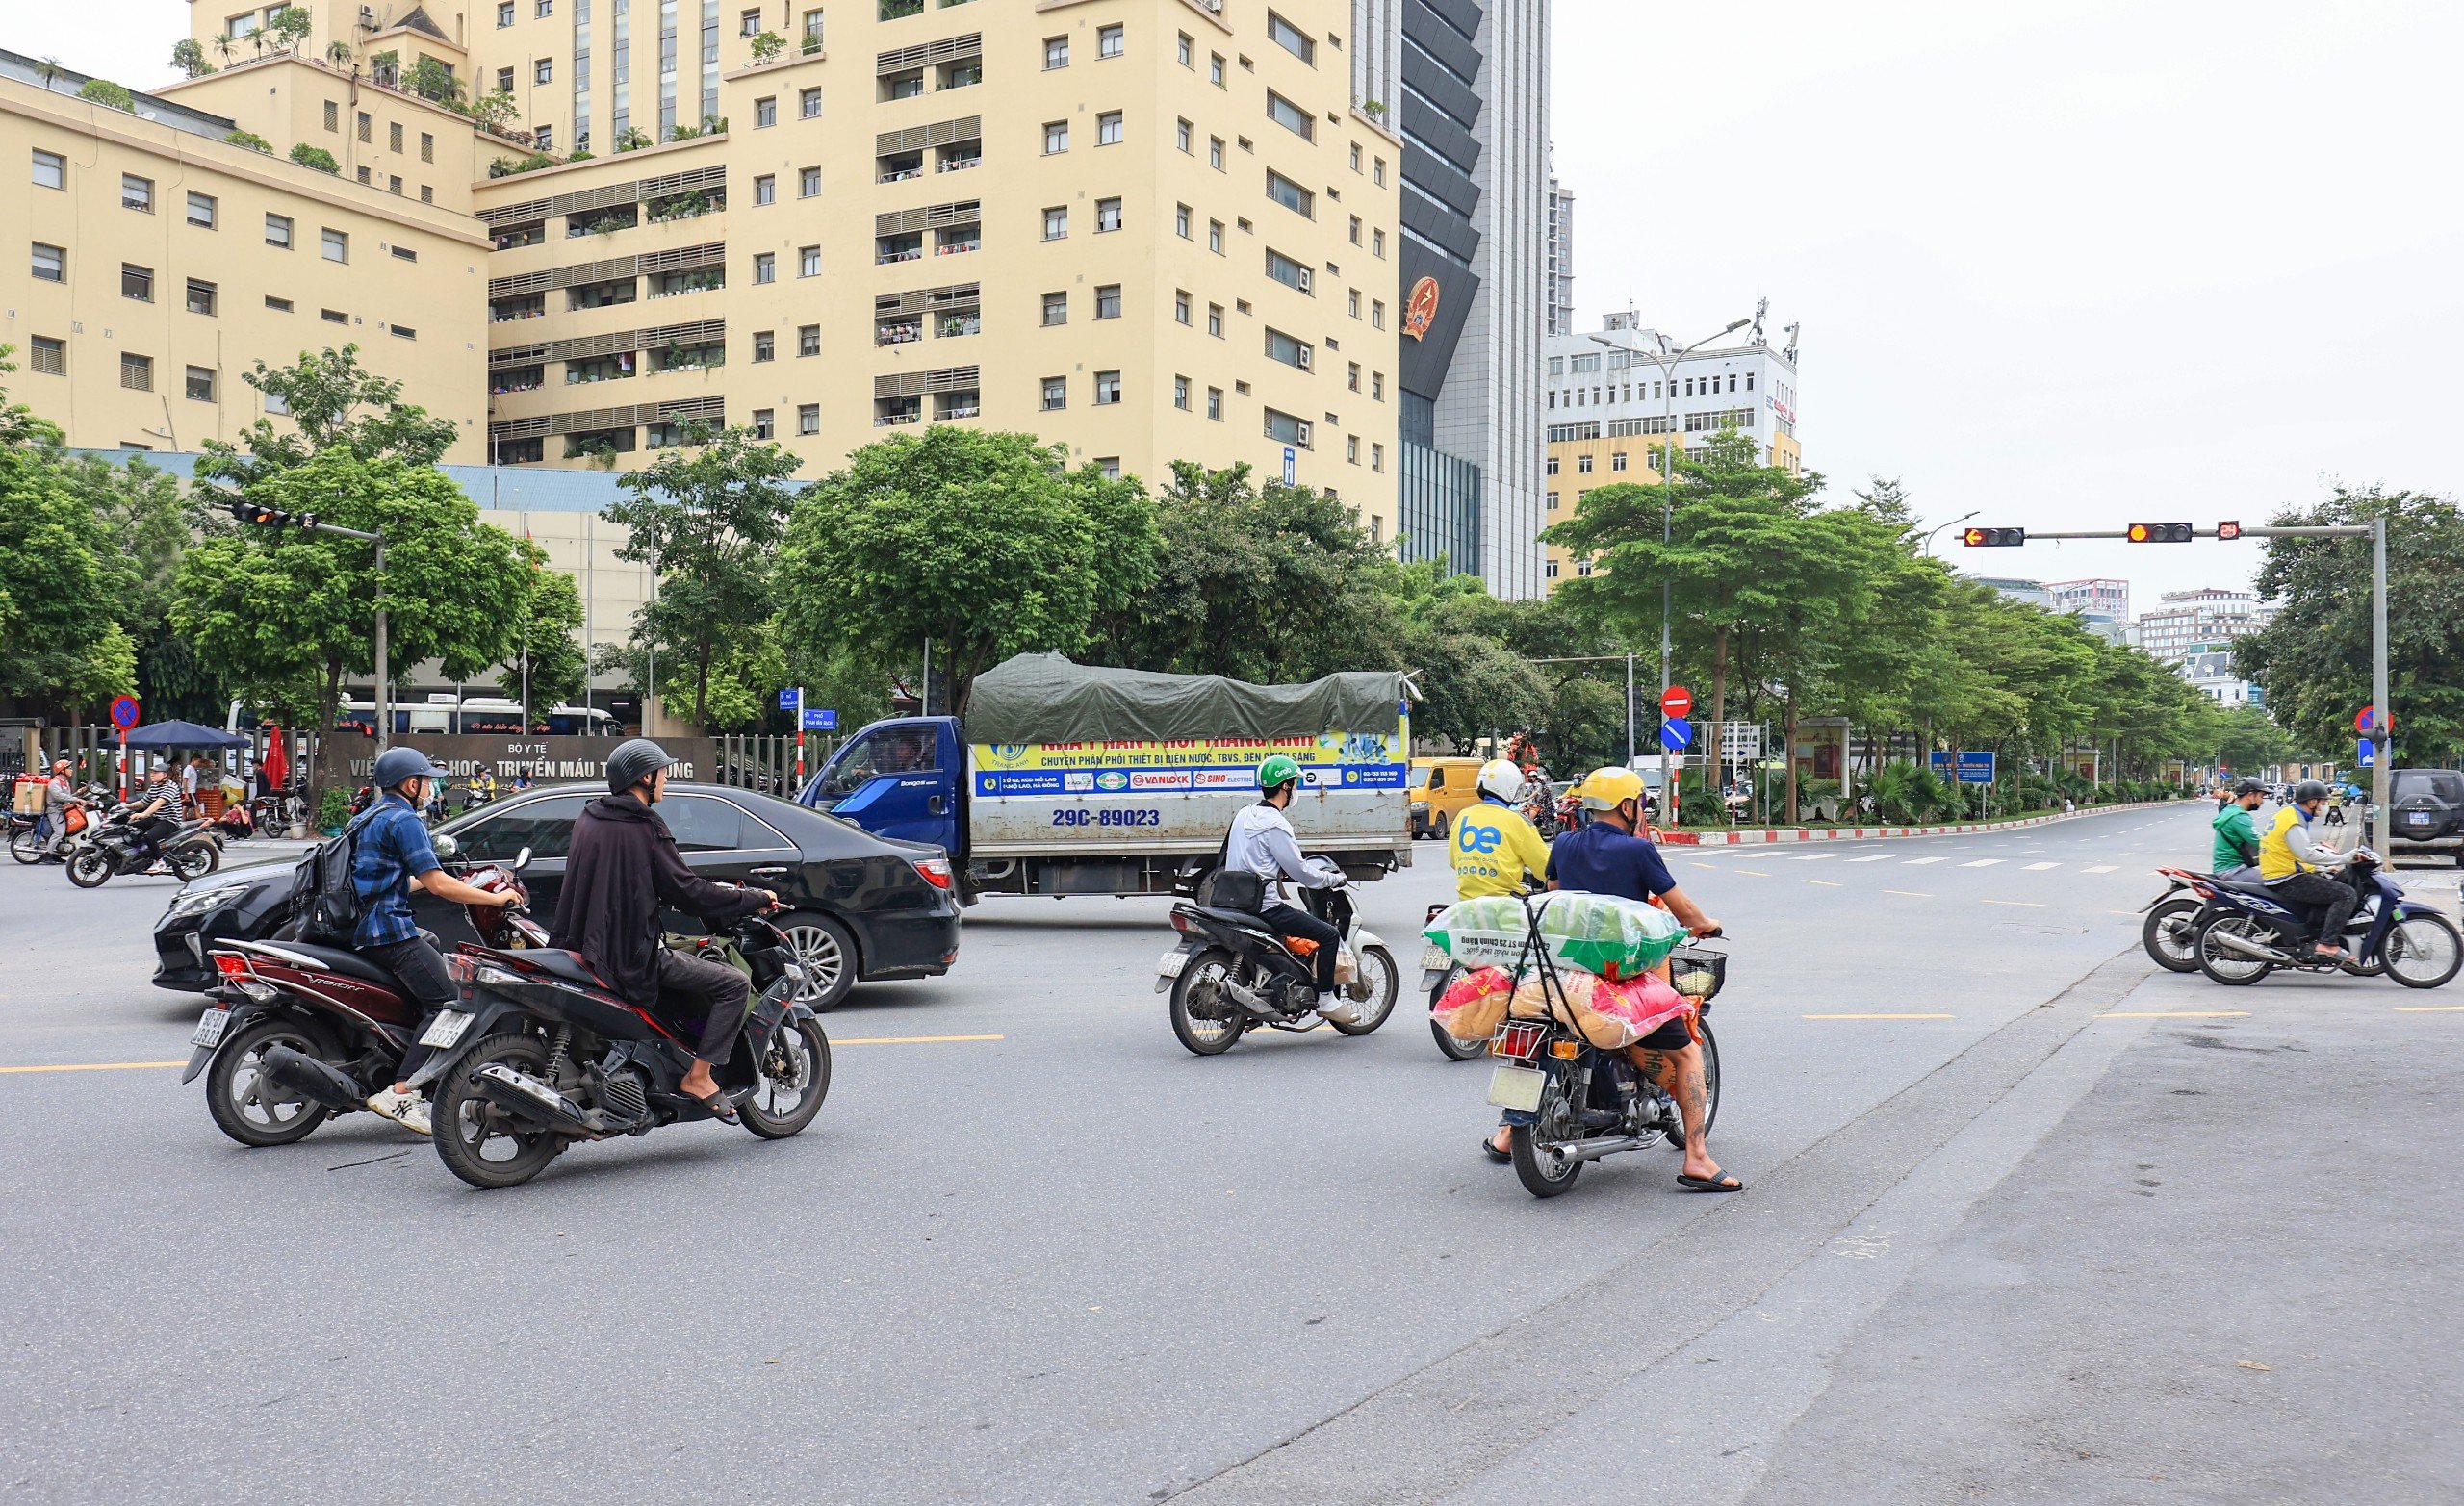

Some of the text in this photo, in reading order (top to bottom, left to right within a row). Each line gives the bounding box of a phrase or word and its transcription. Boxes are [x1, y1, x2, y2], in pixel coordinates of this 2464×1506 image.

[508, 742, 522, 754] BỘ
[535, 741, 548, 753] TẾ
[1041, 755, 1076, 766] CHUYÊN
[1078, 754, 1103, 766] PHÂN
[1129, 753, 1152, 764] THIẾT
[1155, 755, 1163, 765] BỊ
[1166, 753, 1186, 765] ĐIỆN
[350, 756, 375, 779] VIỆ
[560, 758, 595, 778] MÁU
[1275, 766, 1291, 777] Grab
[1145, 775, 1189, 784] VANLOCK
[1207, 775, 1226, 783] SINO
[1052, 809, 1159, 826] 29C-89023
[1459, 816, 1502, 854] be
[1499, 939, 1507, 948] 25
